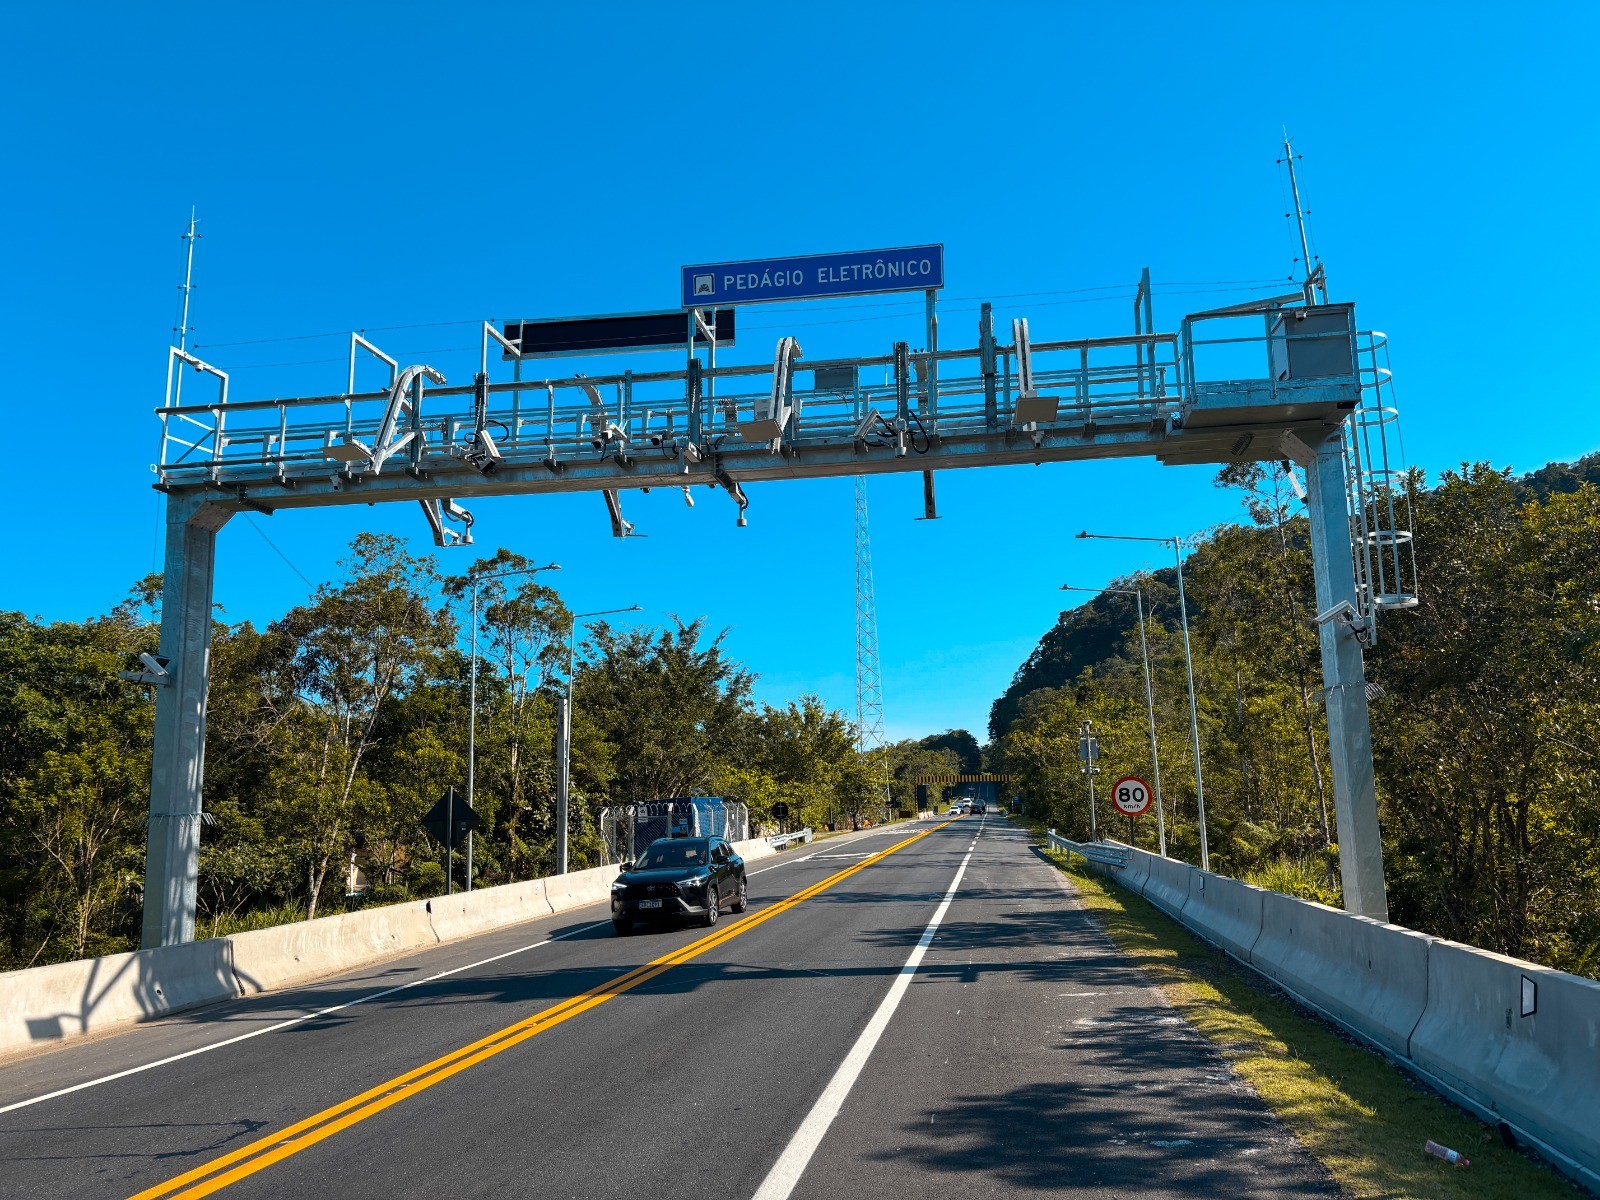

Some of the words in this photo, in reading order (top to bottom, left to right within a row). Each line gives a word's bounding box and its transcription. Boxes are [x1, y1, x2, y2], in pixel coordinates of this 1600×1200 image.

[724, 268, 803, 290] PEDÁGIO
[818, 259, 931, 283] ELETRÔNICO
[1119, 788, 1144, 802] 80
